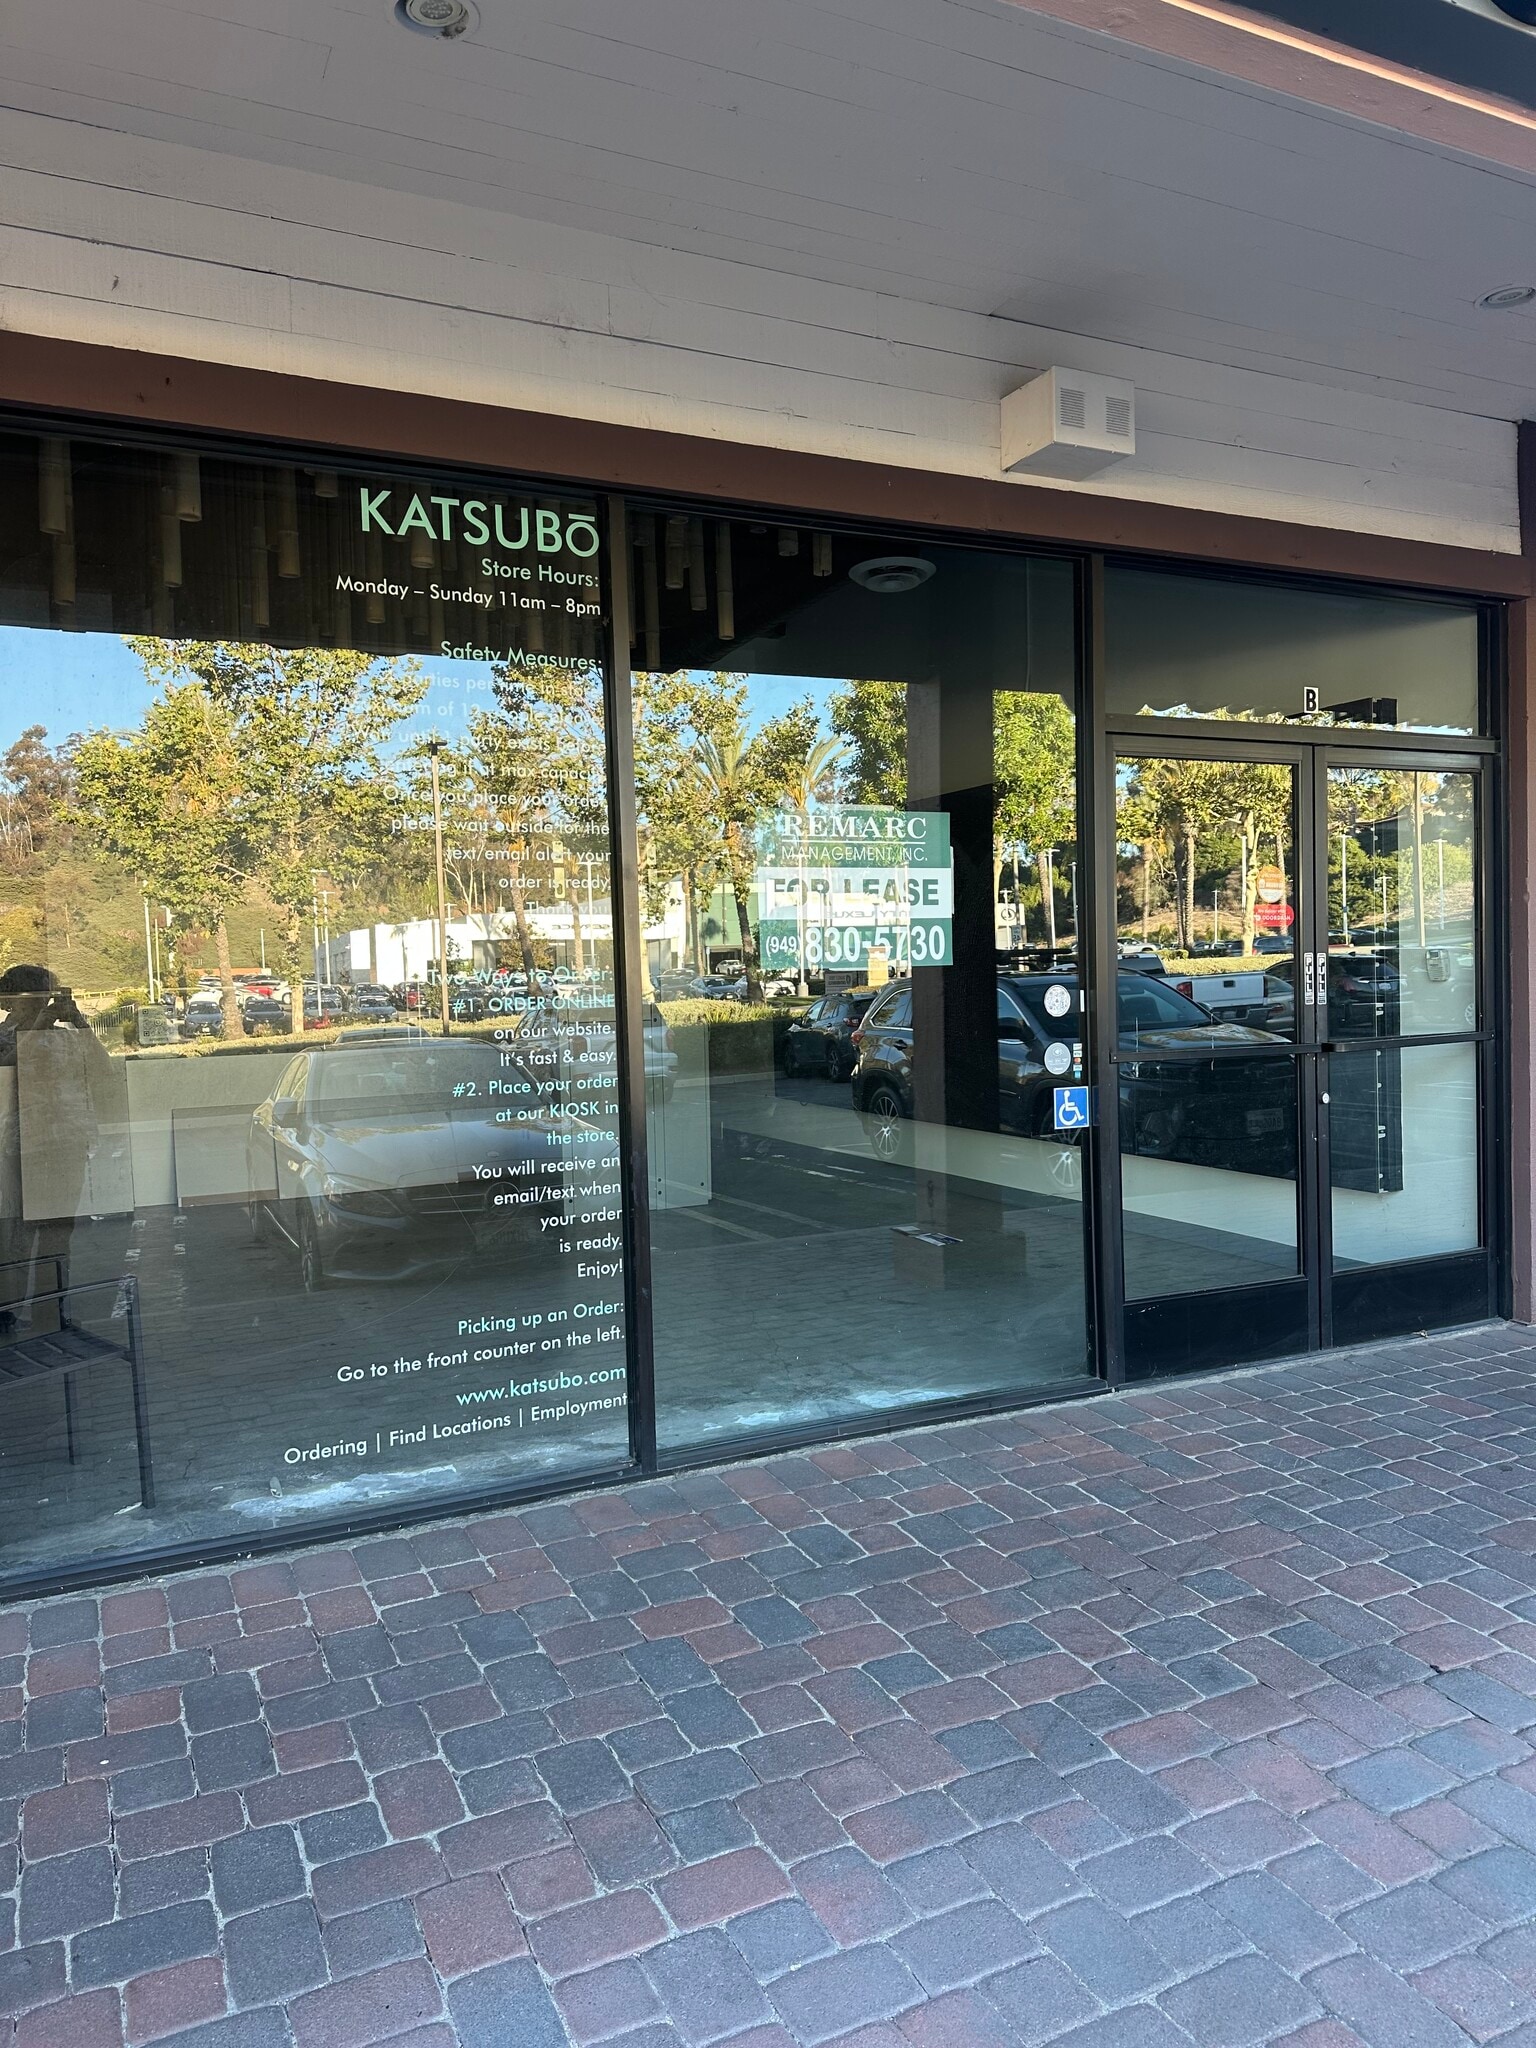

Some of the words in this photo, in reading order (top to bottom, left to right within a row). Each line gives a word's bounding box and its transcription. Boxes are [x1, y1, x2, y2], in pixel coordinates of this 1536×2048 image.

[482, 558, 532, 581] Store
[538, 564, 599, 588] Hours:
[336, 575, 409, 600] Monday
[430, 583, 493, 608] Sunday
[499, 590, 546, 610] 11am
[566, 598, 601, 617] 8pm
[441, 640, 501, 663] Safety
[507, 646, 602, 670] Measures:
[437, 701, 454, 716] of
[1305, 688, 1317, 712] B
[501, 765, 535, 778] max
[473, 789, 517, 809] place
[391, 814, 448, 835] please
[454, 819, 490, 832] wait
[496, 821, 554, 834] outside
[559, 821, 580, 834] for
[587, 821, 610, 835] the
[782, 814, 928, 839] REMARC
[447, 845, 530, 862] text/email
[536, 847, 573, 862] alert
[577, 851, 612, 868] your
[499, 873, 542, 889] order
[549, 874, 561, 889] is
[774, 877, 830, 907] FOR
[844, 878, 939, 907] LEASE
[766, 935, 800, 958] (949)
[805, 924, 946, 964] 830-5730
[427, 968, 466, 986] Two
[474, 967, 522, 988] Ways
[529, 968, 547, 983] to
[1305, 957, 1313, 992] PULL
[1318, 957, 1326, 992] PULL
[452, 998, 482, 1014] #1.
[488, 996, 546, 1013] ORDER
[552, 994, 615, 1010] ONLINE
[494, 1028, 515, 1040] on
[521, 1027, 548, 1039] our
[552, 1022, 616, 1036] website.
[528, 1051, 558, 1066] fast
[563, 1050, 575, 1063] &
[579, 1051, 616, 1066] easy.
[452, 1081, 482, 1097] #2.
[489, 1080, 531, 1095] Place
[535, 1080, 571, 1096] your
[577, 1074, 619, 1089] order
[495, 1109, 511, 1122] at
[517, 1108, 545, 1120] our
[550, 1102, 600, 1118] KIOSK
[605, 1101, 619, 1114] in
[547, 1131, 571, 1145] the
[577, 1129, 619, 1143] store.
[472, 1164, 502, 1180] You
[507, 1159, 535, 1175] will
[541, 1156, 596, 1174] receive
[601, 1156, 621, 1168] an
[493, 1185, 576, 1206] email/text
[579, 1181, 621, 1197] when
[540, 1213, 577, 1231] your
[581, 1207, 623, 1223] order
[559, 1238, 571, 1253] is
[576, 1232, 623, 1252] ready.
[577, 1258, 623, 1279] Enjoy!
[458, 1314, 517, 1336] Picking
[522, 1312, 542, 1329] up
[547, 1309, 568, 1323] an
[573, 1301, 625, 1319] Order:
[337, 1365, 365, 1383] Go
[370, 1362, 388, 1378] to
[393, 1357, 422, 1374] the
[427, 1350, 468, 1369] front
[473, 1340, 536, 1362] counter
[541, 1336, 561, 1351] on
[566, 1329, 592, 1346] the
[596, 1325, 625, 1342] left.
[455, 1367, 627, 1406] www.katsubo.com
[284, 1436, 368, 1464] Ordering
[389, 1423, 427, 1447] Find
[433, 1411, 512, 1439] Locations
[531, 1393, 628, 1422] Employment
